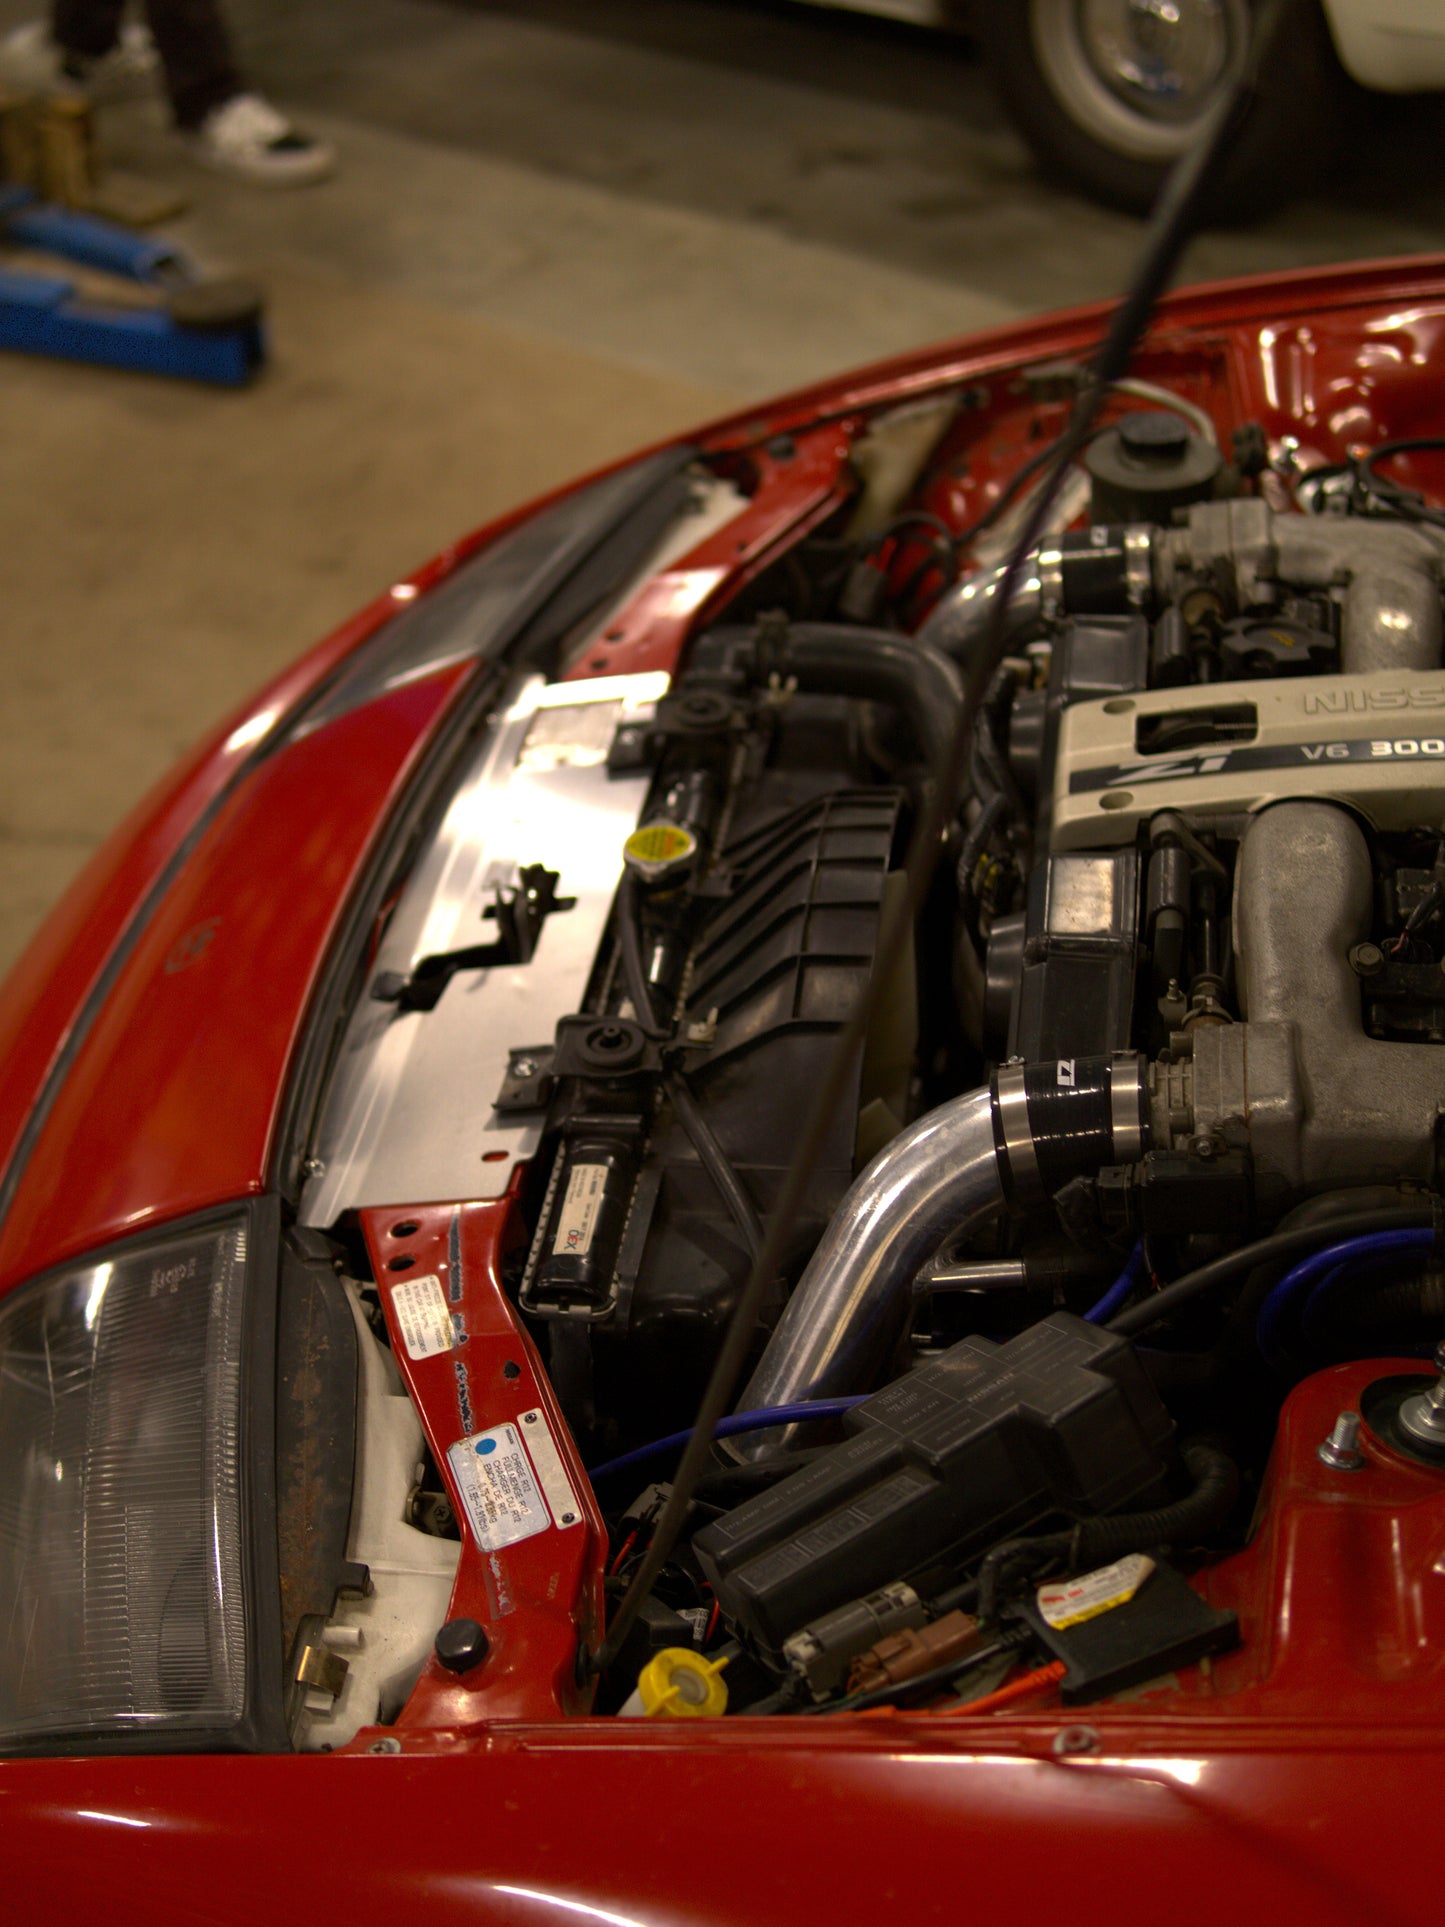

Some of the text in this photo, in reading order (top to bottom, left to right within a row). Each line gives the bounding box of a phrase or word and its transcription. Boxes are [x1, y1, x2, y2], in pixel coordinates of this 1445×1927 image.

[1301, 743, 1349, 760] V6
[1371, 739, 1445, 756] 300
[564, 1229, 579, 1250] OEX
[493, 1460, 511, 1494] CHARGER
[505, 1496, 515, 1508] DU
[493, 1489, 502, 1500] DE
